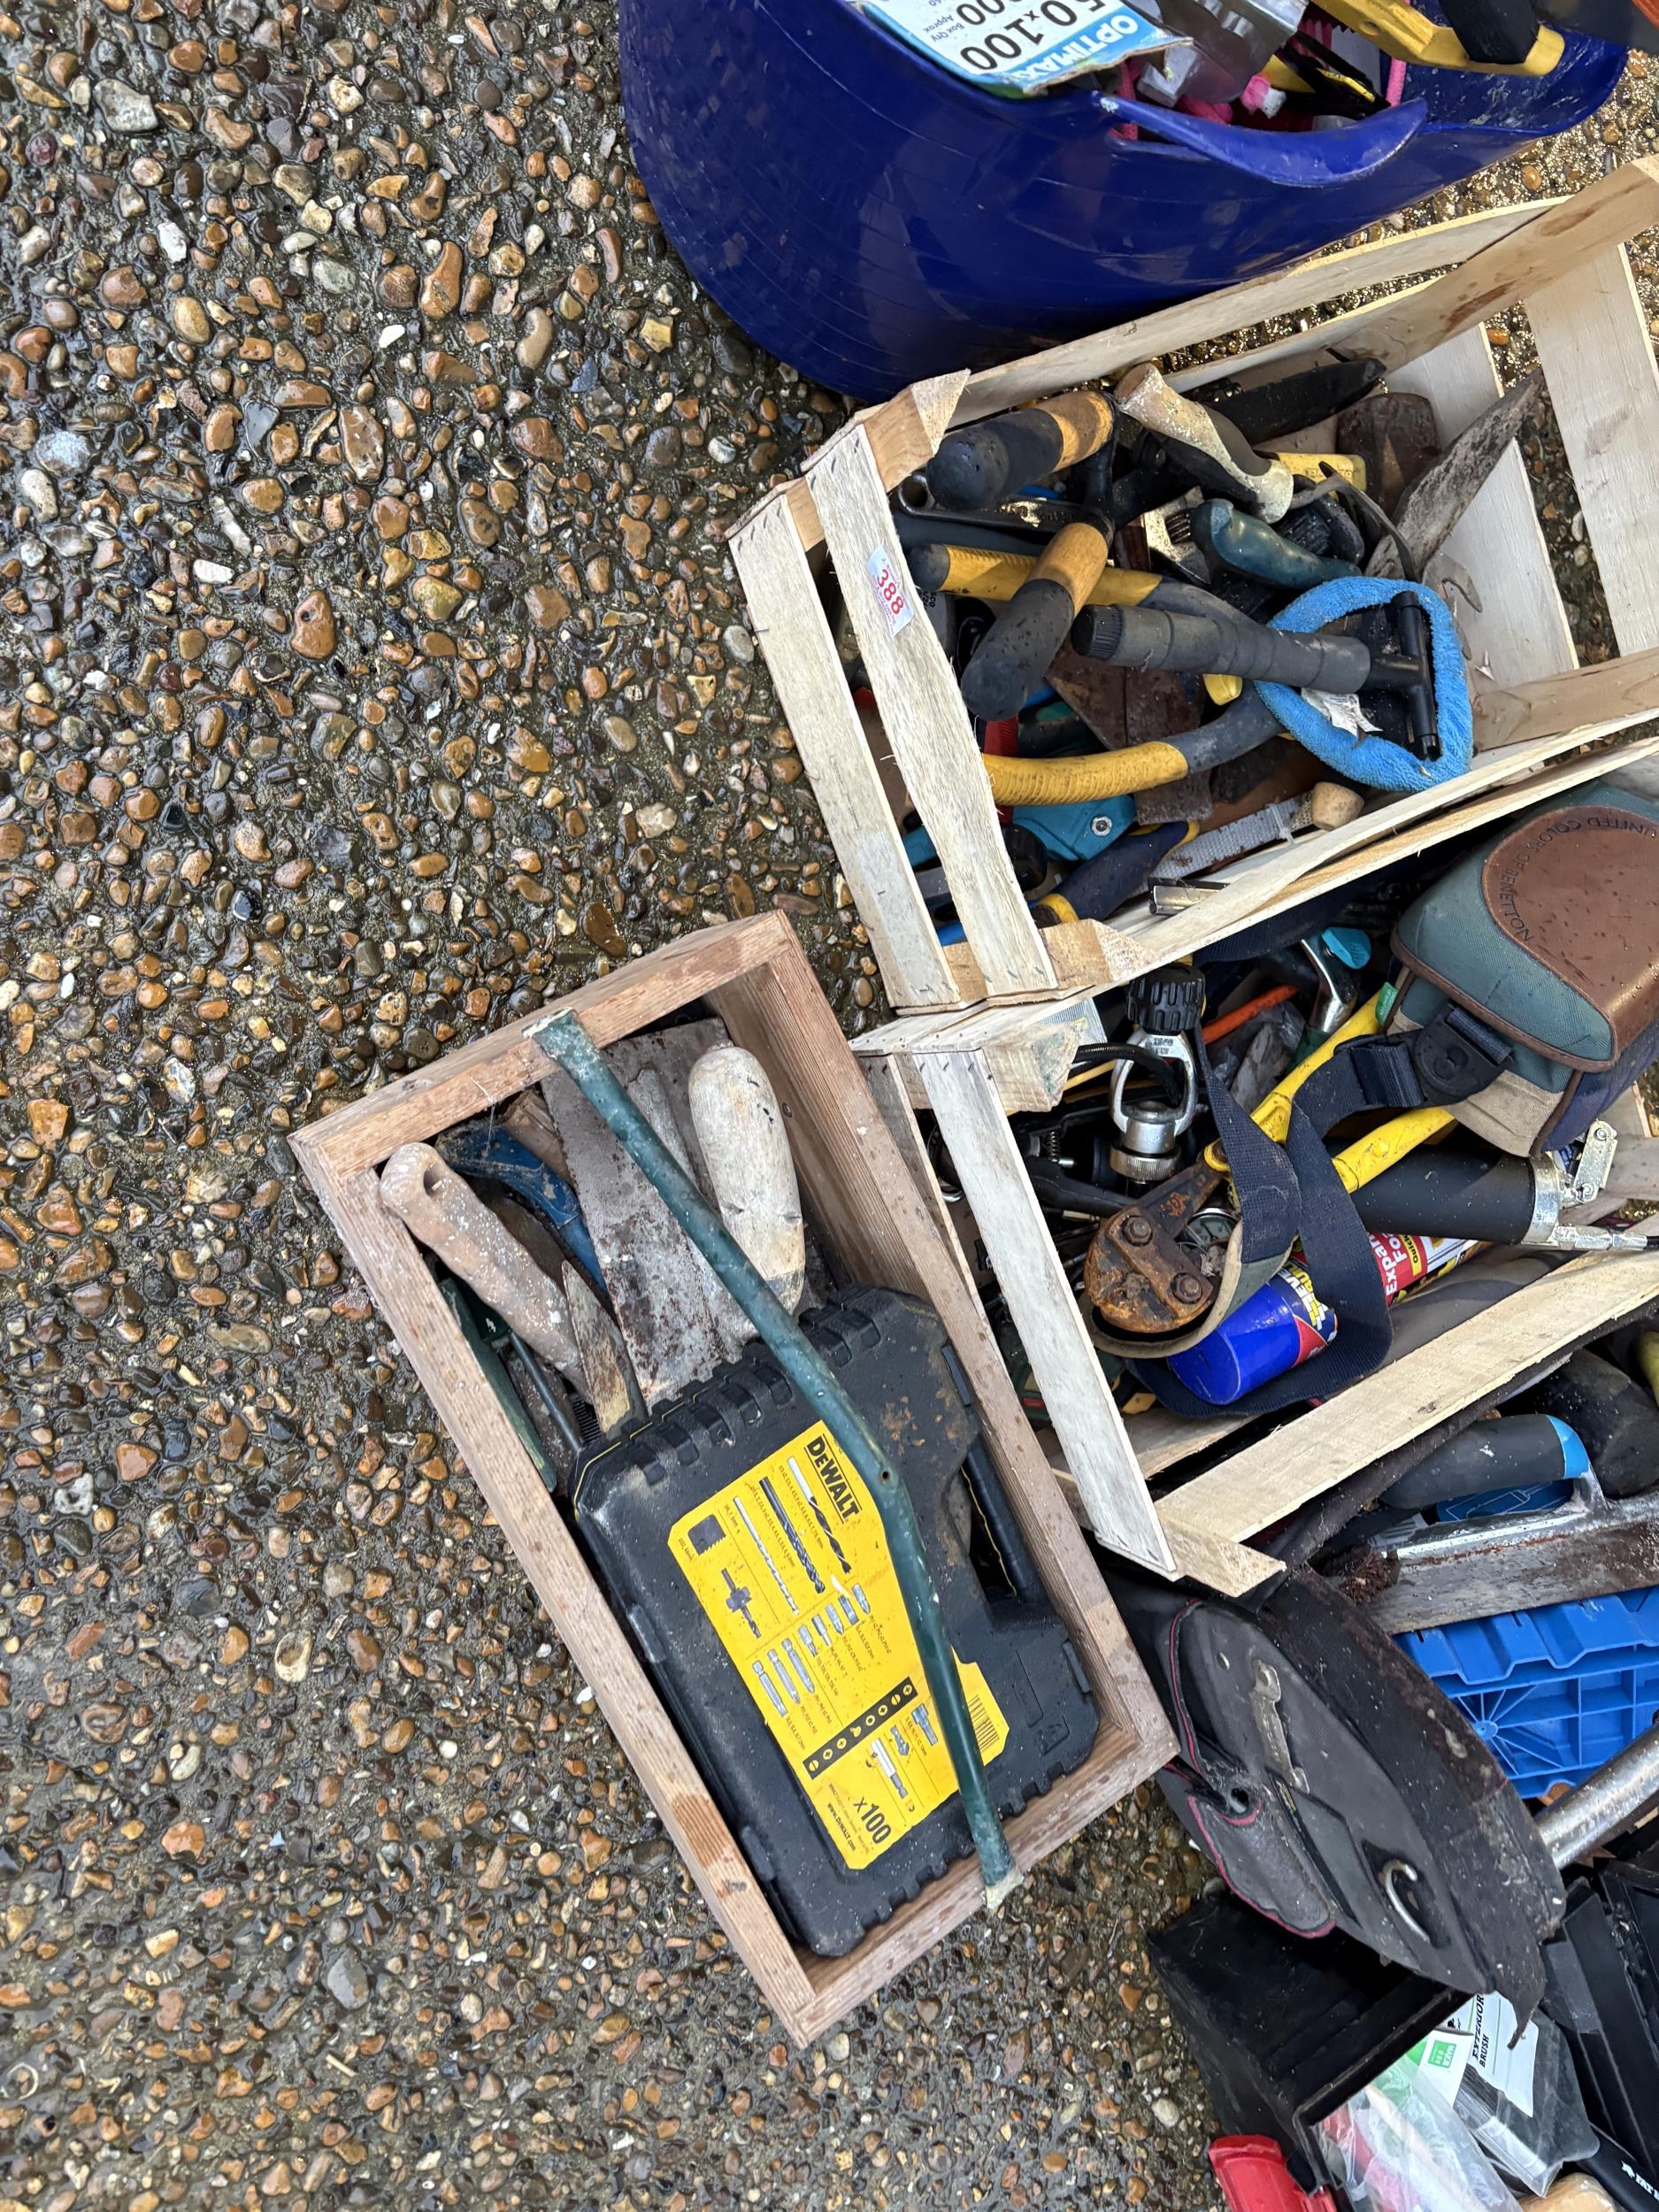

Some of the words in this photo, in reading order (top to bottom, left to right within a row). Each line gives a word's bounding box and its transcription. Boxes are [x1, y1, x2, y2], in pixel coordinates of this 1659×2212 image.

[924, 14, 954, 33] Approx
[931, 32, 949, 42] Qty
[947, 23, 964, 33] Box
[878, 569, 904, 614] 388
[1529, 819, 1581, 852] COLORS
[1586, 817, 1657, 839] UNITED
[1514, 852, 1530, 872] OF
[1500, 868, 1534, 942] BENETTON
[1472, 1993, 1485, 2061] EXTERIOR
[1479, 2033, 1490, 2069] BRUSH
